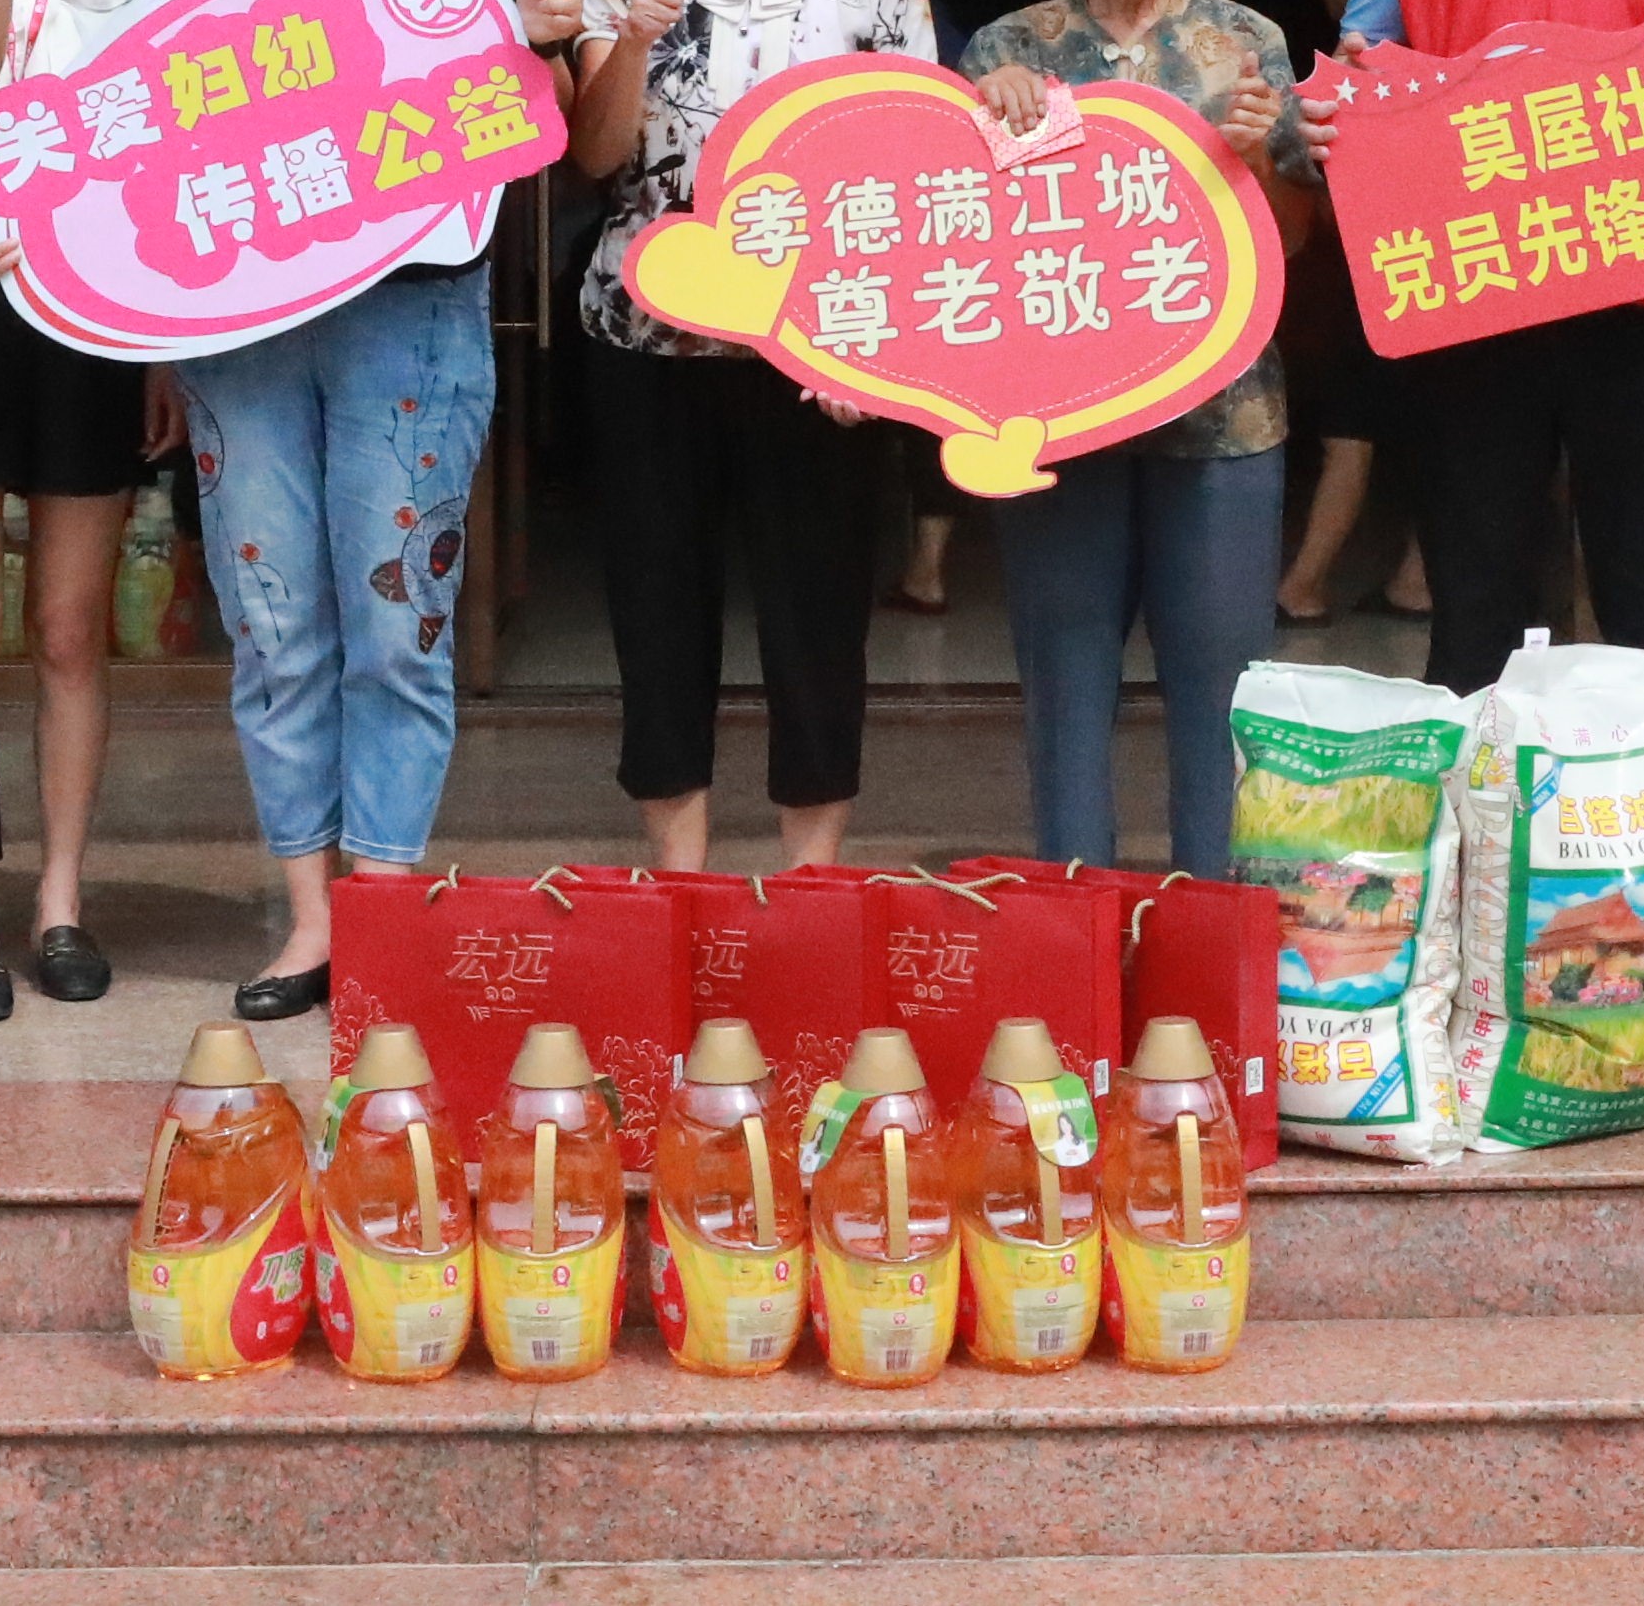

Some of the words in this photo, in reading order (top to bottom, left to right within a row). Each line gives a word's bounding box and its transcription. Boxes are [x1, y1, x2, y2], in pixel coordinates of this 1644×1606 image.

[174, 64, 541, 256] 传播公益
[730, 146, 1181, 266] 孝德满江城
[808, 235, 1213, 358] 尊老敬老
[445, 928, 554, 984] 宏远
[887, 925, 979, 985] 宏远
